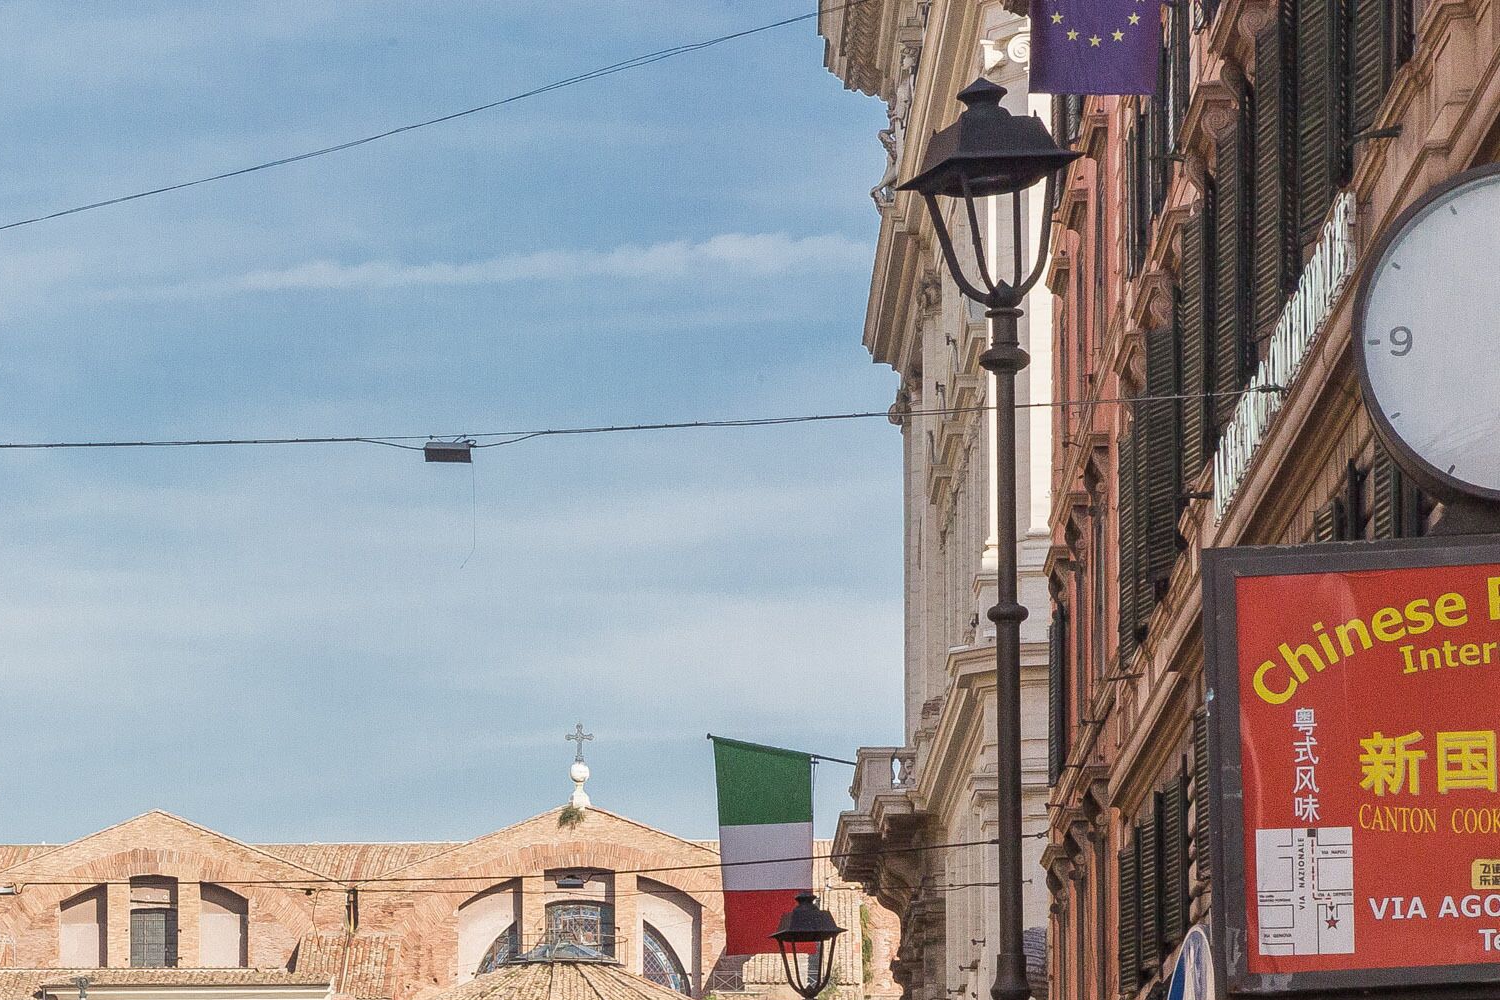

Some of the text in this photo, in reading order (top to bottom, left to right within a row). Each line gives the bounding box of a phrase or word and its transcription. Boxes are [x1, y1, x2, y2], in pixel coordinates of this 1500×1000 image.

[1389, 326, 1413, 356] 9
[1253, 592, 1468, 705] Chinese
[1292, 707, 1320, 822] 粤式风味
[1359, 804, 1437, 834] CANTON
[1369, 896, 1427, 920] VIA
